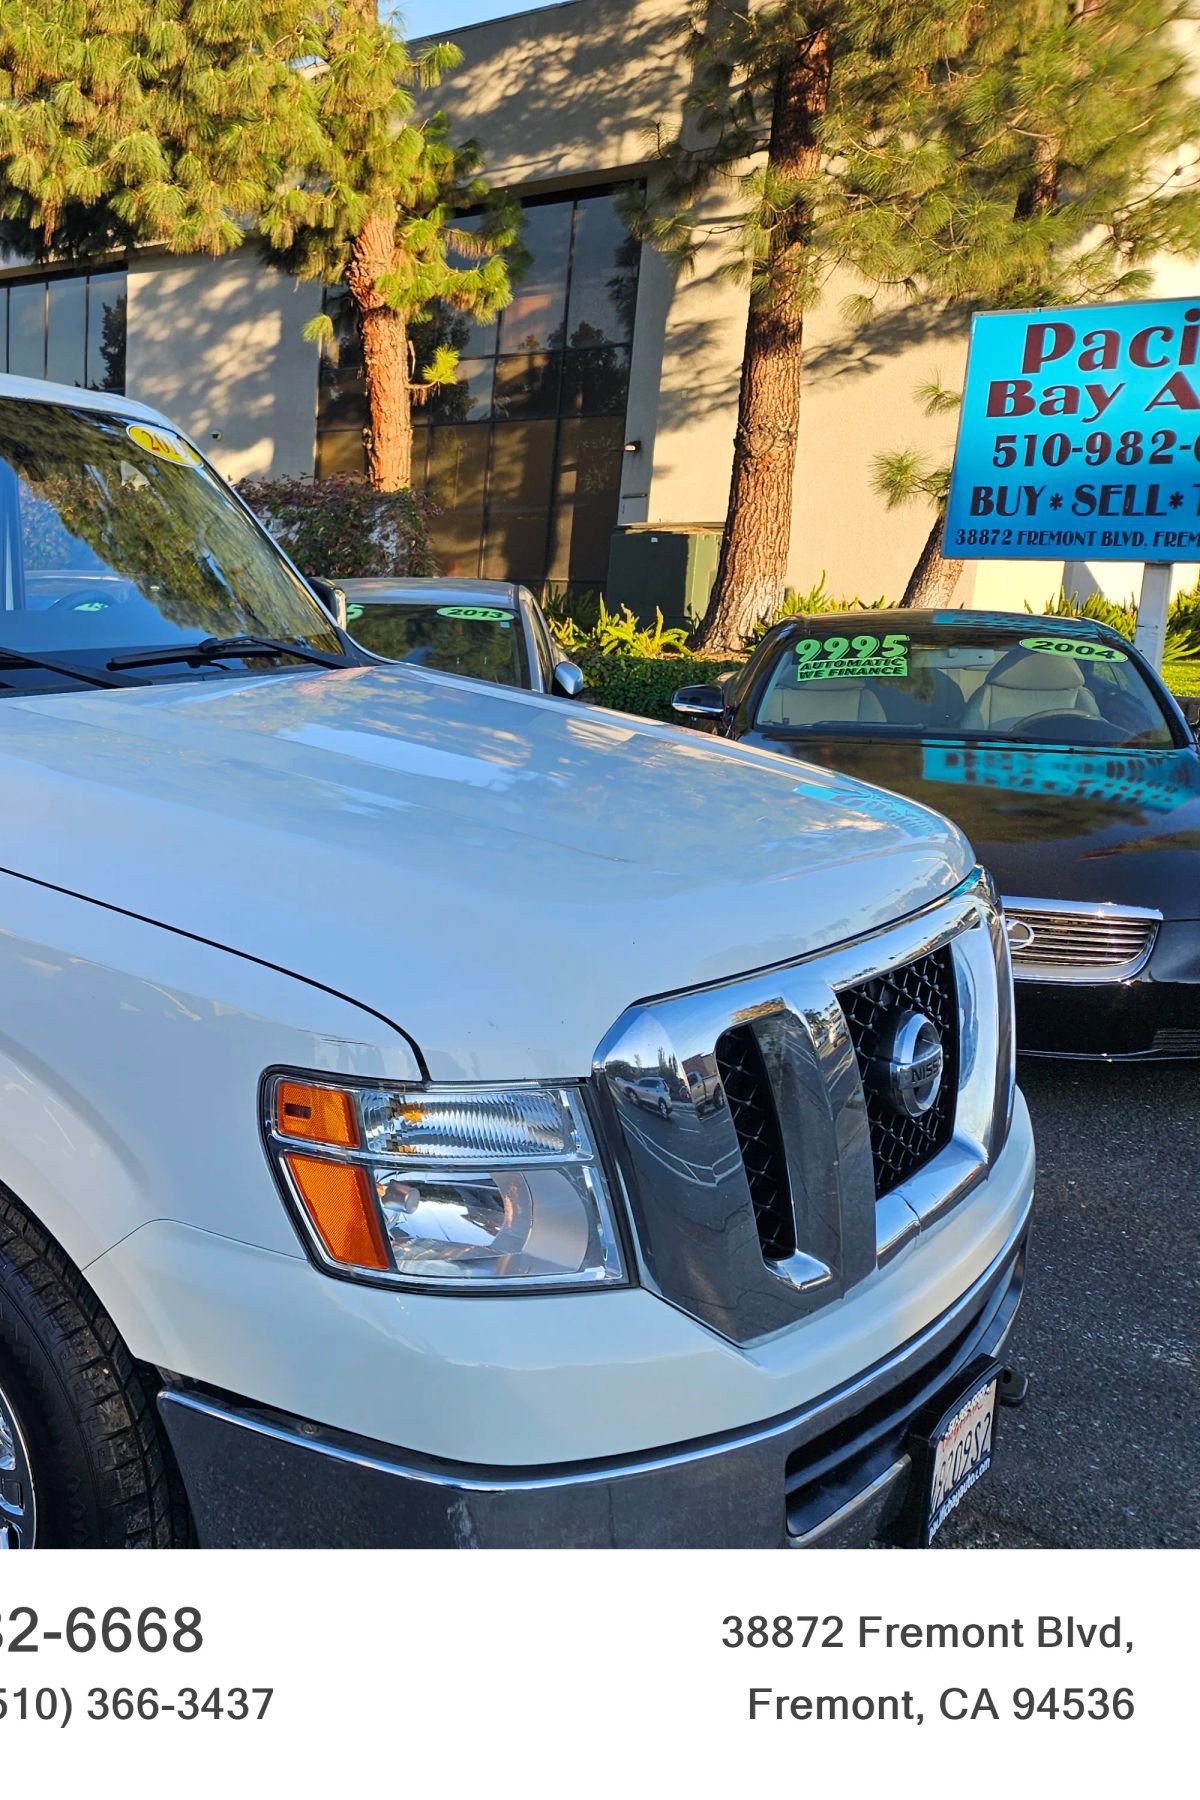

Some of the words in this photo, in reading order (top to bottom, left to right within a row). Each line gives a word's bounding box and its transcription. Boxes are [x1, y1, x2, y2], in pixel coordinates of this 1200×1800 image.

[1022, 308, 1200, 374] Paci
[986, 379, 1126, 424] Bay
[992, 429, 1200, 468] 510-982-
[970, 485, 1046, 517] BUY
[955, 529, 1012, 546] 38872
[1017, 530, 1097, 547] FREMONT
[447, 608, 504, 619] 2013
[795, 634, 910, 662] 9995
[1032, 640, 1116, 659] 2004
[799, 669, 822, 680] WE
[828, 667, 904, 677] FINANCE
[801, 658, 904, 670] AUTOMATIC
